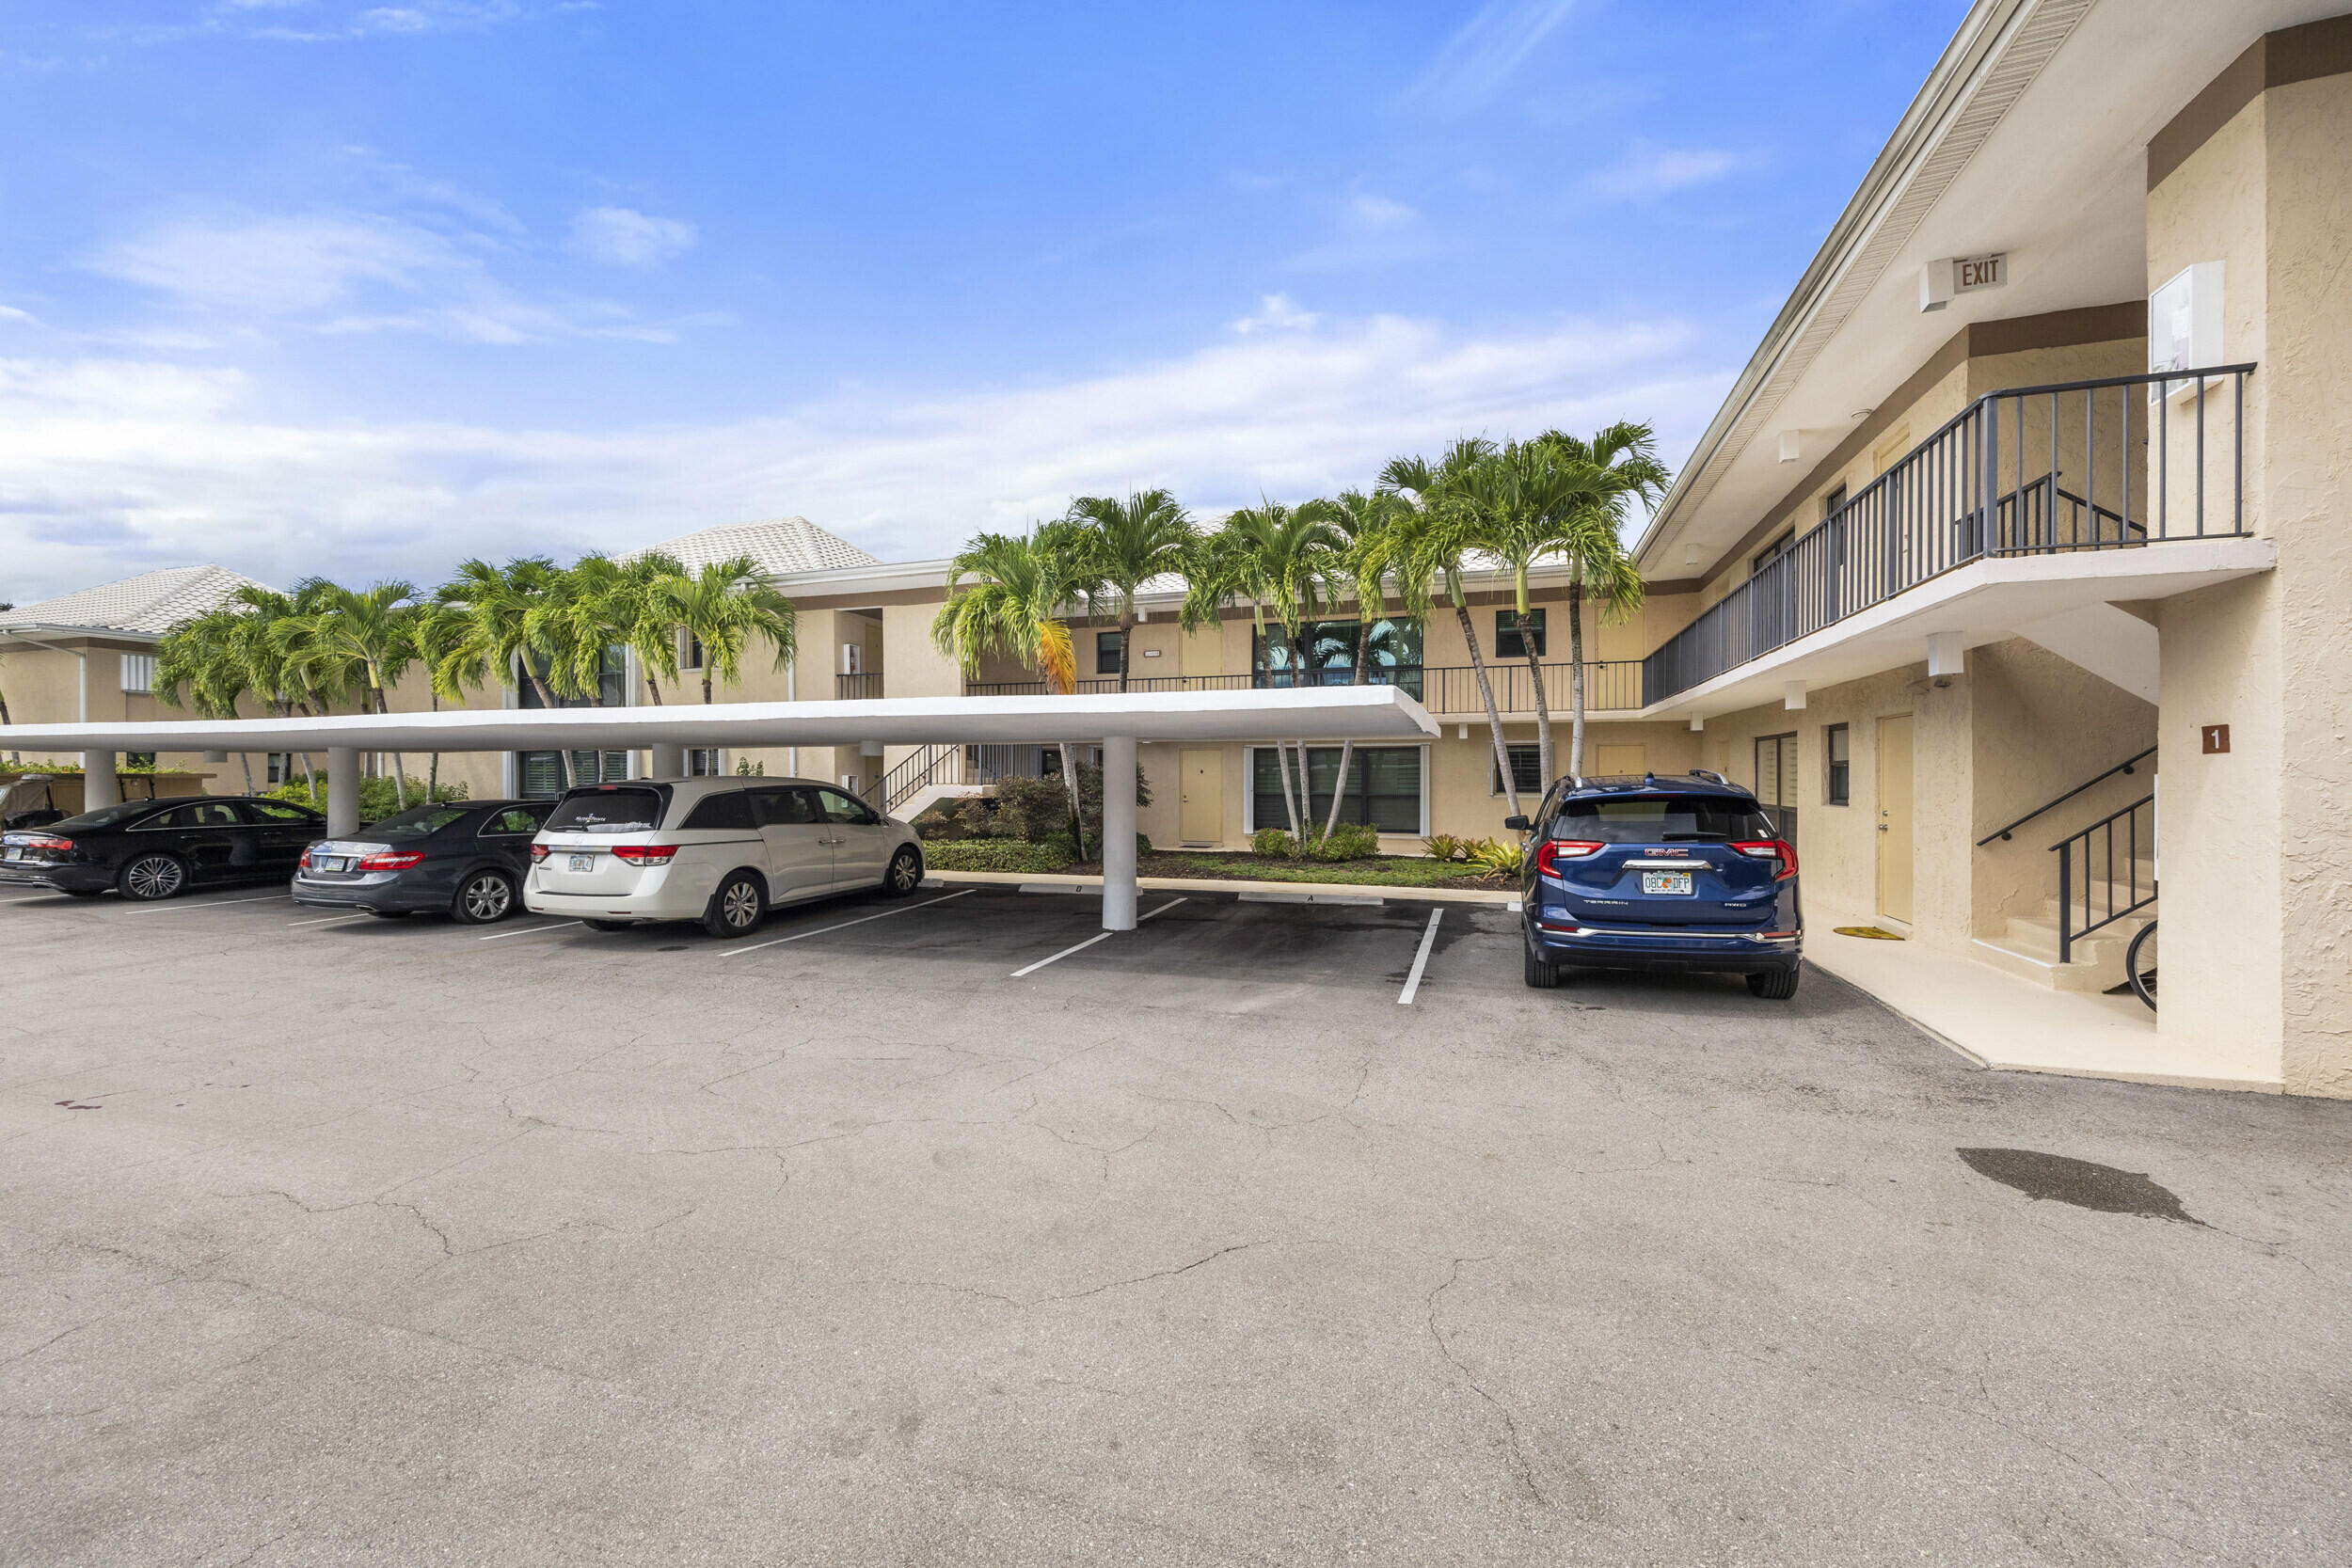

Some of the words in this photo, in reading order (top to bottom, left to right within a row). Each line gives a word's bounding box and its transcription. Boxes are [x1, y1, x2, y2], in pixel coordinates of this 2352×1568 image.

[1963, 260, 1998, 286] EXIT
[2211, 729, 2219, 750] 1
[1645, 848, 1689, 857] GMC
